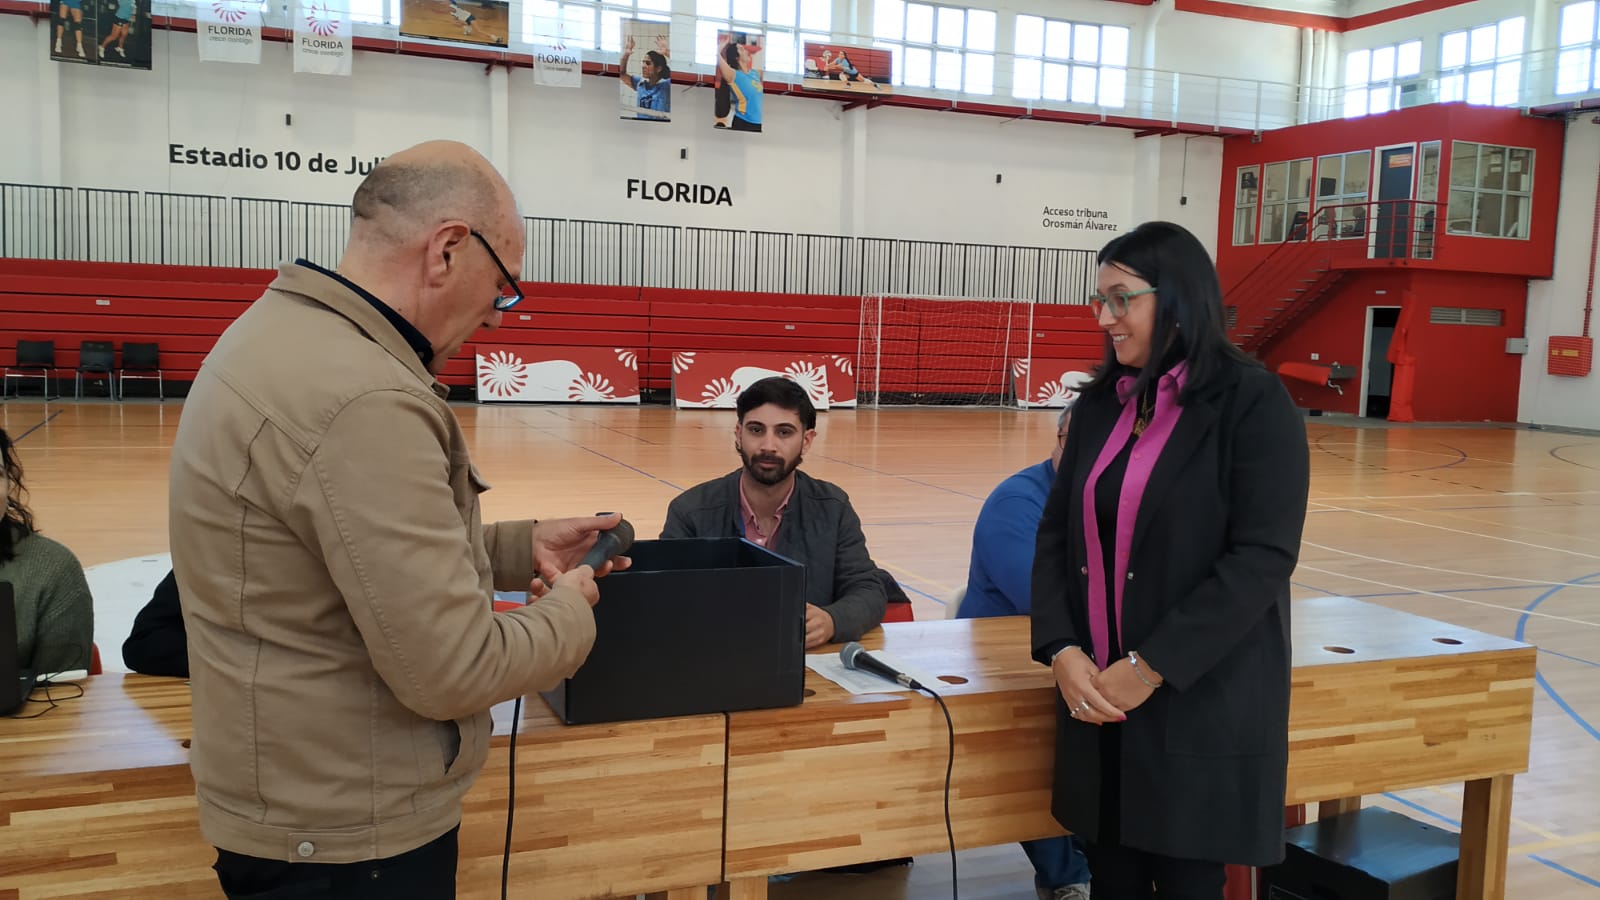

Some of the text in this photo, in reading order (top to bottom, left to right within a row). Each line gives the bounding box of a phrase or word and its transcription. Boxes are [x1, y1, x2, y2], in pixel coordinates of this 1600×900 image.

[208, 25, 252, 37] FLORIDA
[302, 37, 343, 49] FLORIDA
[537, 53, 577, 65] FLORIDA
[169, 143, 385, 176] Estadio 10 de Ju
[627, 178, 733, 207] FLORIDA
[1043, 206, 1108, 218] Acceso tribuna
[1042, 218, 1118, 231] Orosmán Álvarez
